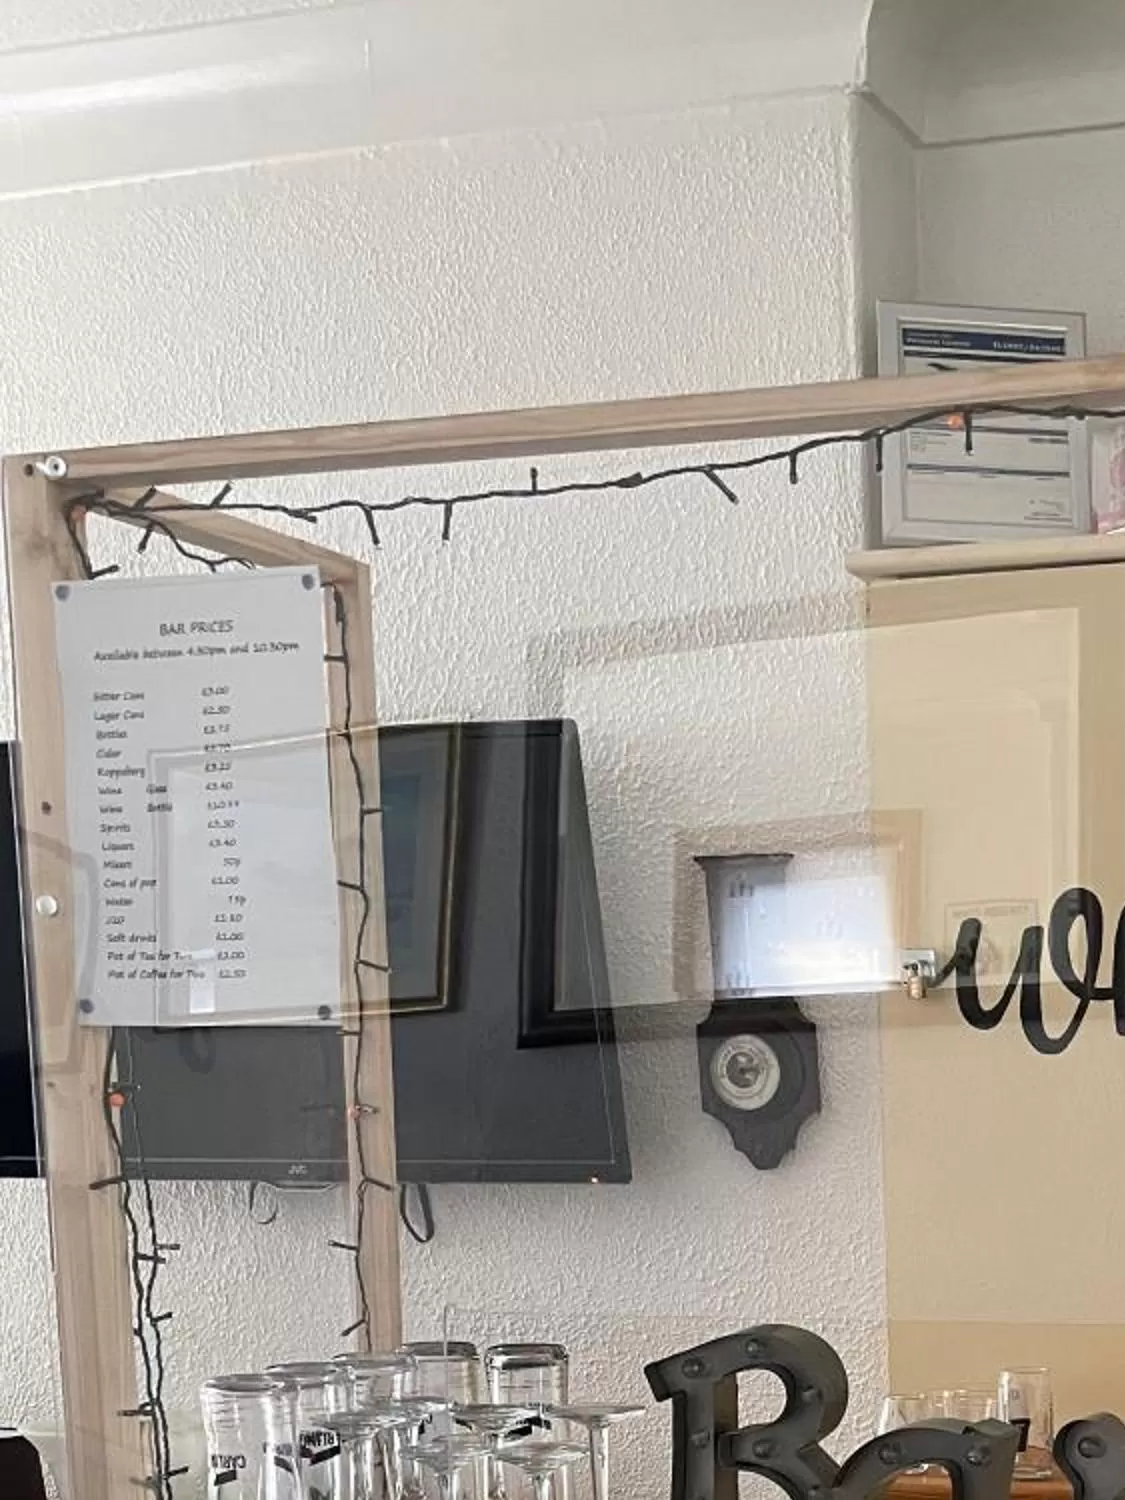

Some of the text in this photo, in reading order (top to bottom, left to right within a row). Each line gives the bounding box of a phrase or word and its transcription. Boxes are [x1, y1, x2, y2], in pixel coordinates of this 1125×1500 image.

[159, 619, 234, 637] BAR PRICES
[93, 647, 140, 661] Available
[143, 647, 183, 660] between
[230, 641, 250, 654] and
[93, 709, 121, 723] Lager
[123, 708, 145, 720] Cans
[95, 747, 122, 759] Cider
[98, 785, 123, 795] Wine
[99, 804, 123, 814] Wine
[99, 823, 131, 836] Spirits
[103, 878, 127, 889] Cans
[129, 877, 139, 889] of
[106, 932, 126, 943] Soft
[128, 932, 157, 943] drinks
[107, 950, 125, 961] Pot
[139, 950, 156, 961] Tea
[157, 949, 171, 961] for
[107, 968, 125, 979] Pot
[127, 967, 138, 979] of
[139, 968, 167, 979] Coffee
[169, 967, 184, 979] for
[185, 968, 206, 979] Two
